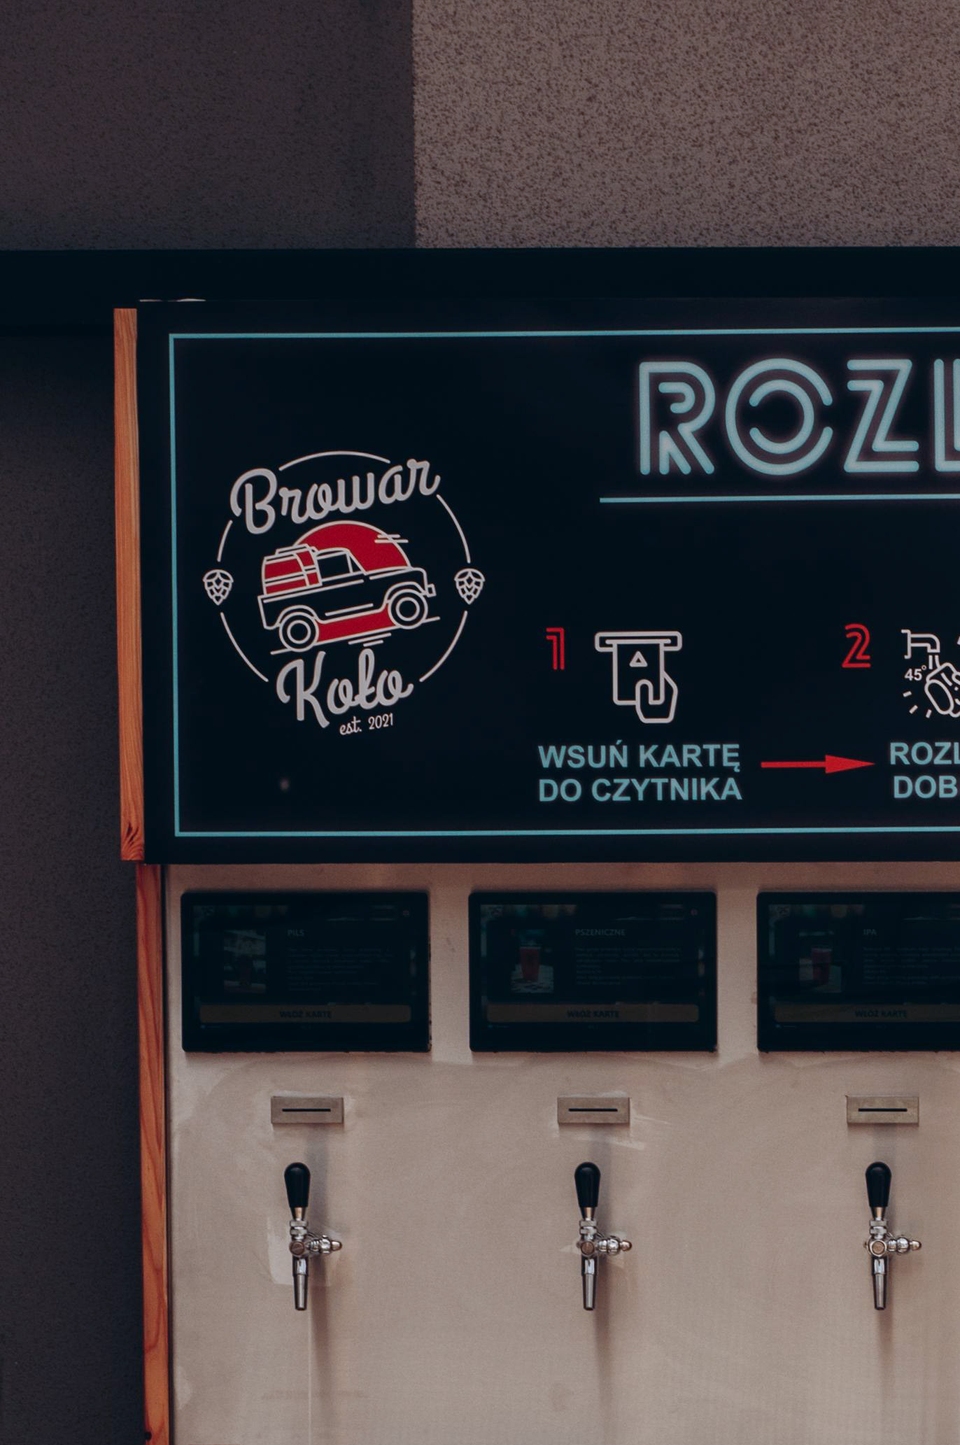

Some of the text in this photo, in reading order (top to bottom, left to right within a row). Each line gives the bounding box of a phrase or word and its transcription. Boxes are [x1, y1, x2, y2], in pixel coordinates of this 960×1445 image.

[230, 458, 441, 534] Browar
[546, 627, 565, 669] 1
[842, 624, 871, 668] 2
[276, 648, 414, 728] Koło
[340, 713, 394, 735] est. 2021
[538, 740, 740, 772] WSUŃ KARTĘ
[540, 778, 742, 801] DO CZYTNIKA
[575, 928, 626, 937] PSZENICZNE
[863, 928, 877, 936] IPA
